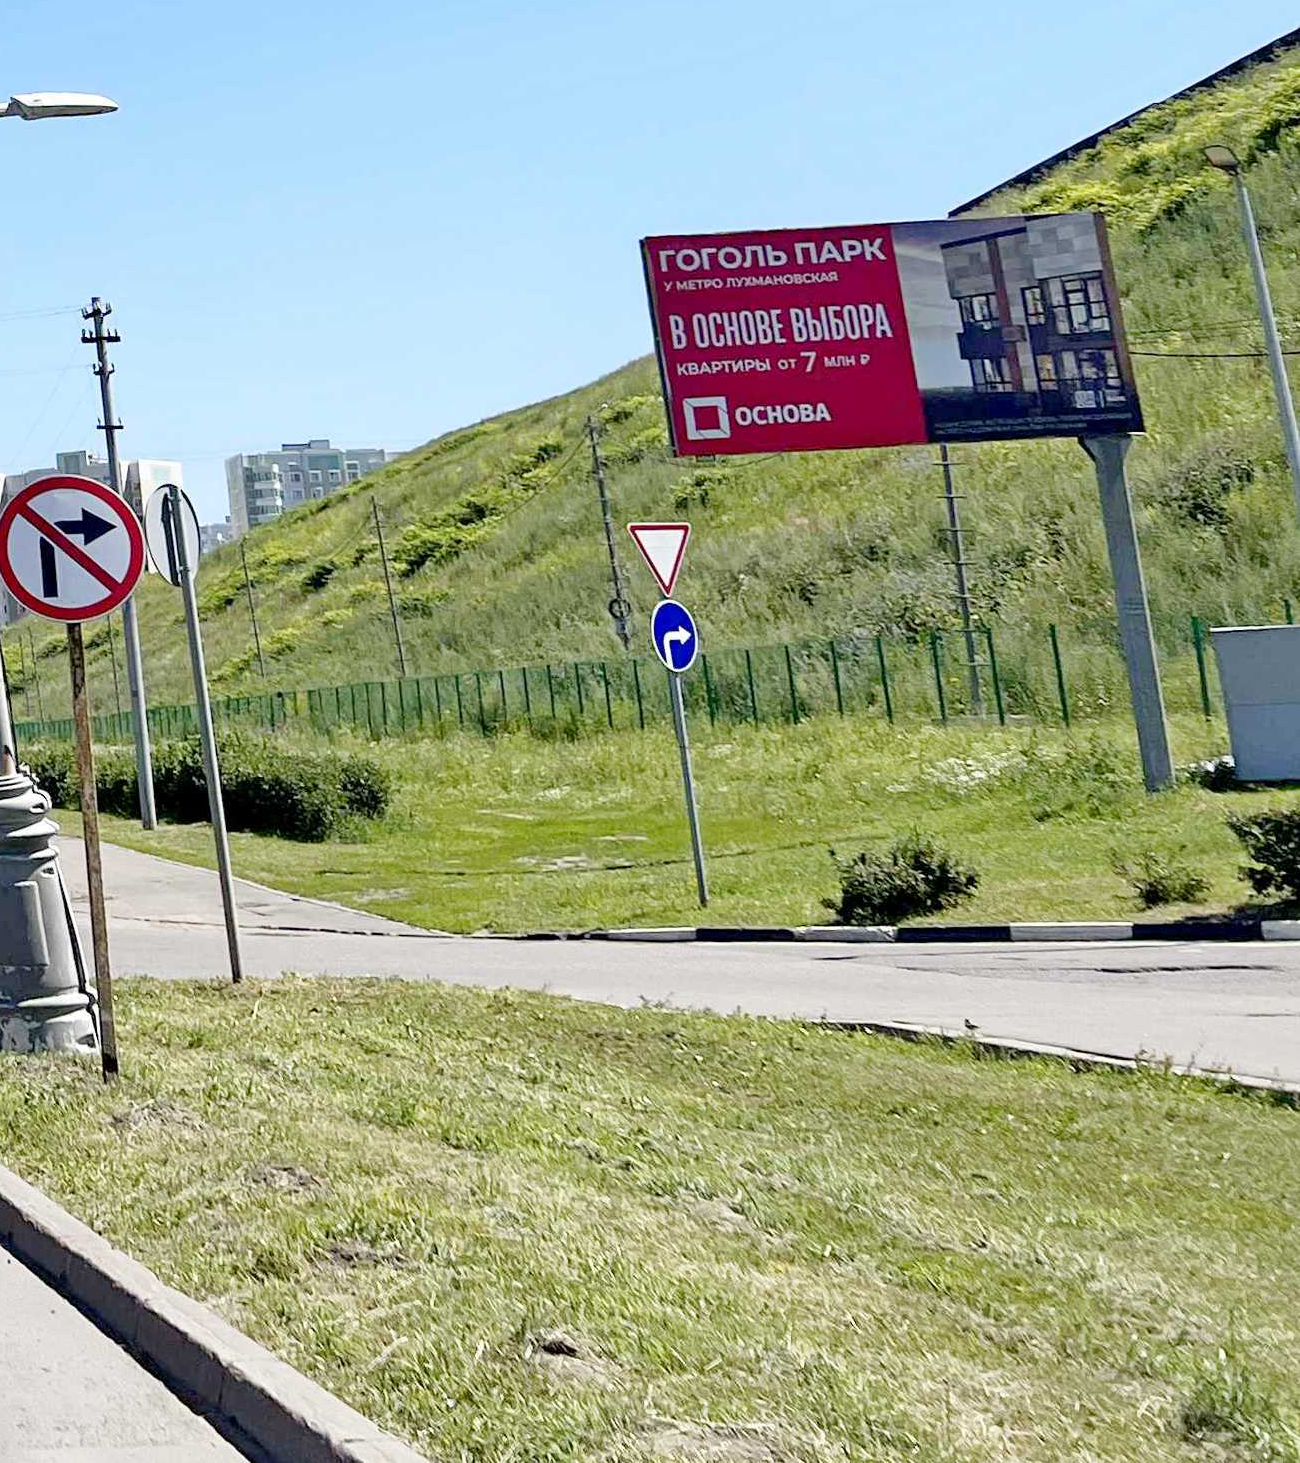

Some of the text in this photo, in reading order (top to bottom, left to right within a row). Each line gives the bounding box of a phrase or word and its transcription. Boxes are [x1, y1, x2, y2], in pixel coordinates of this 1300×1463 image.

[657, 238, 888, 273] ГОГОЛЬ ПАРК
[663, 271, 840, 293] У МЕТРО ЛУХМАНОВСКАЯ
[669, 302, 894, 350] В ОСНОВЕ ВЫБОРА
[676, 358, 772, 377] КВАРТИРЫ
[800, 351, 817, 373] 7
[734, 402, 832, 427] ОСНОВА
